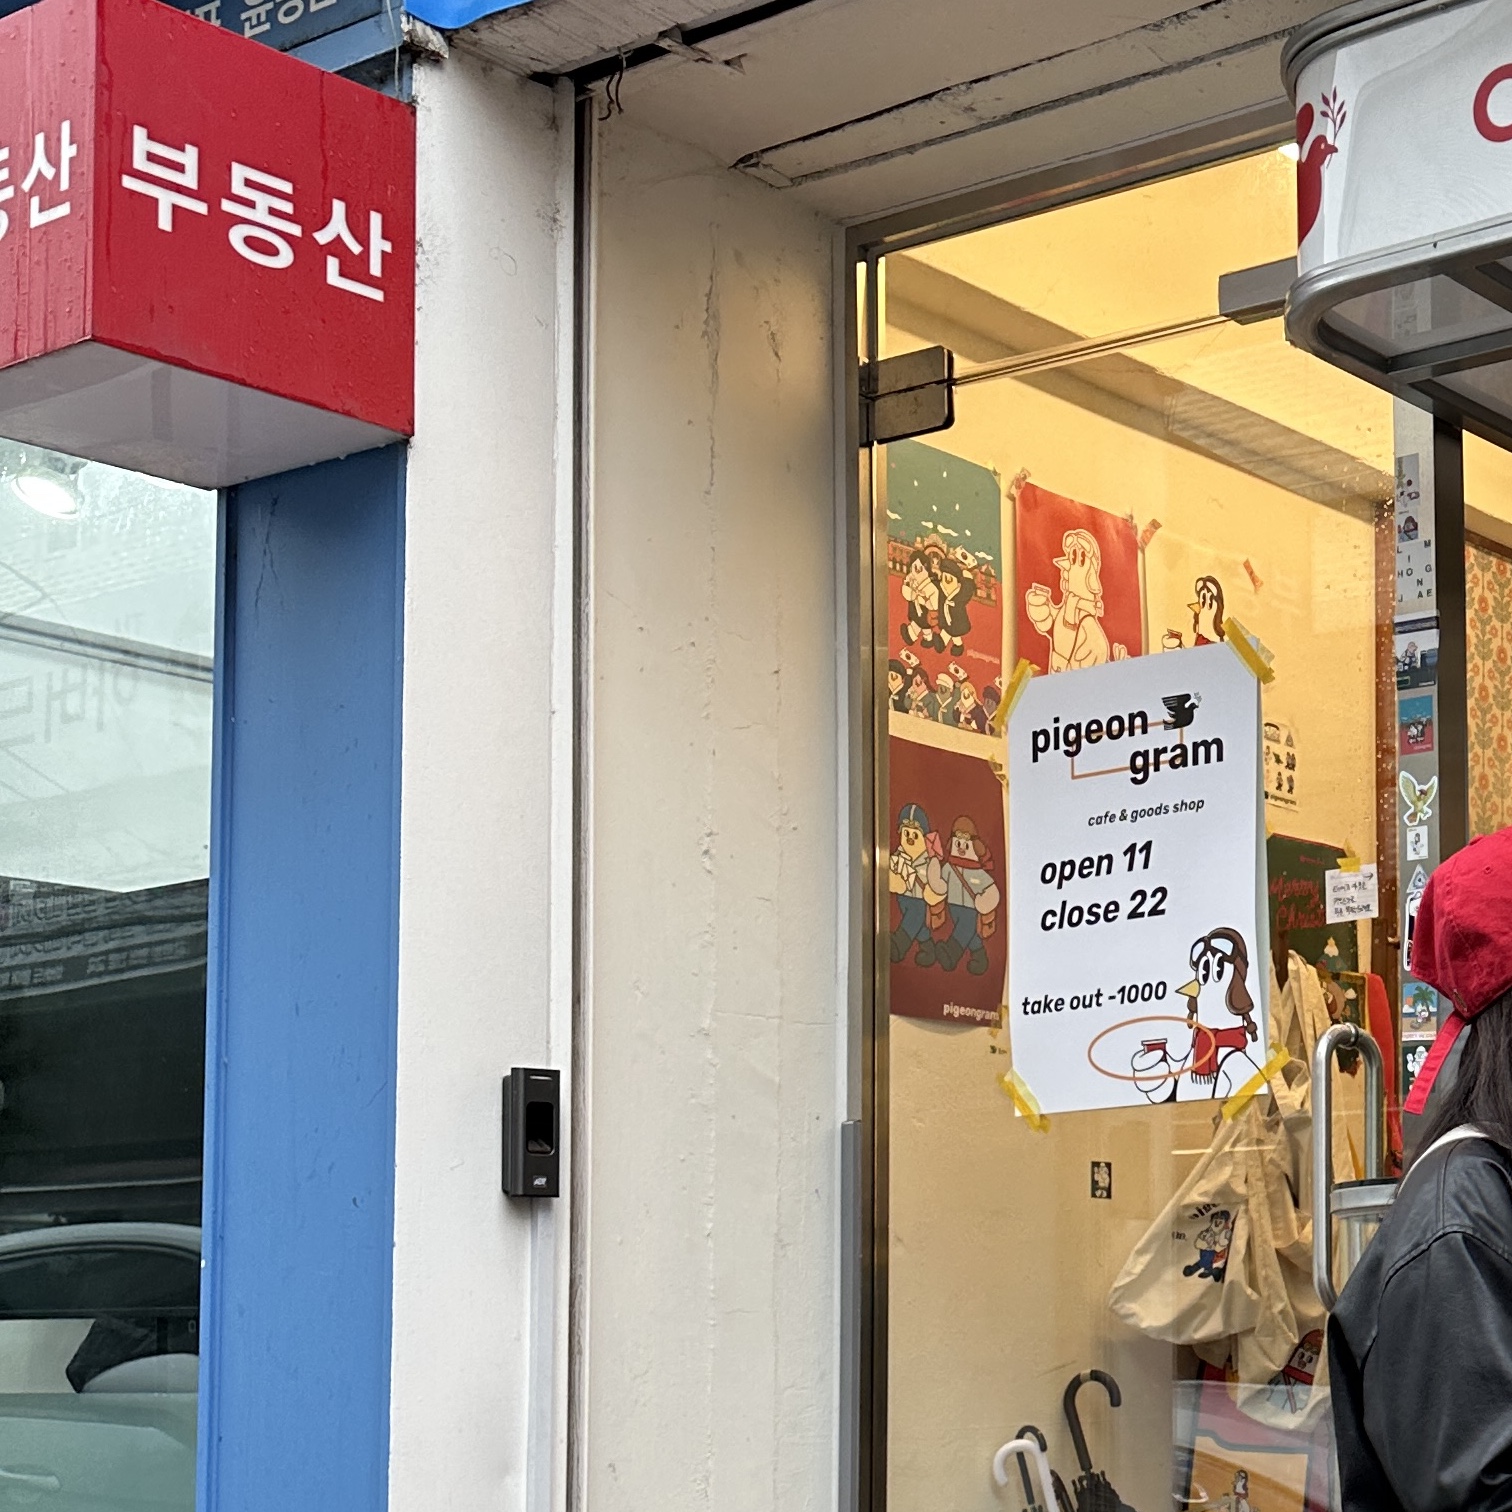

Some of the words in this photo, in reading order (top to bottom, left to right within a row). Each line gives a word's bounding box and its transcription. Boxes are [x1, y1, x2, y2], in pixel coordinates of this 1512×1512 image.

[0, 119, 77, 243] 산
[121, 124, 392, 302] 부동산
[1031, 709, 1148, 763] pigeon
[1129, 736, 1224, 785] gram
[1088, 811, 1116, 827] cafe
[1119, 809, 1128, 821] &
[1130, 802, 1170, 823] goods
[1172, 797, 1205, 813] shop
[1040, 852, 1114, 890] open
[1123, 840, 1153, 872] 11
[1040, 900, 1120, 932] close
[1127, 886, 1168, 920] 22
[943, 1002, 1000, 1021] pigeongram
[1022, 994, 1065, 1016] take
[1070, 988, 1103, 1010] out
[1108, 980, 1167, 1005] -1000
